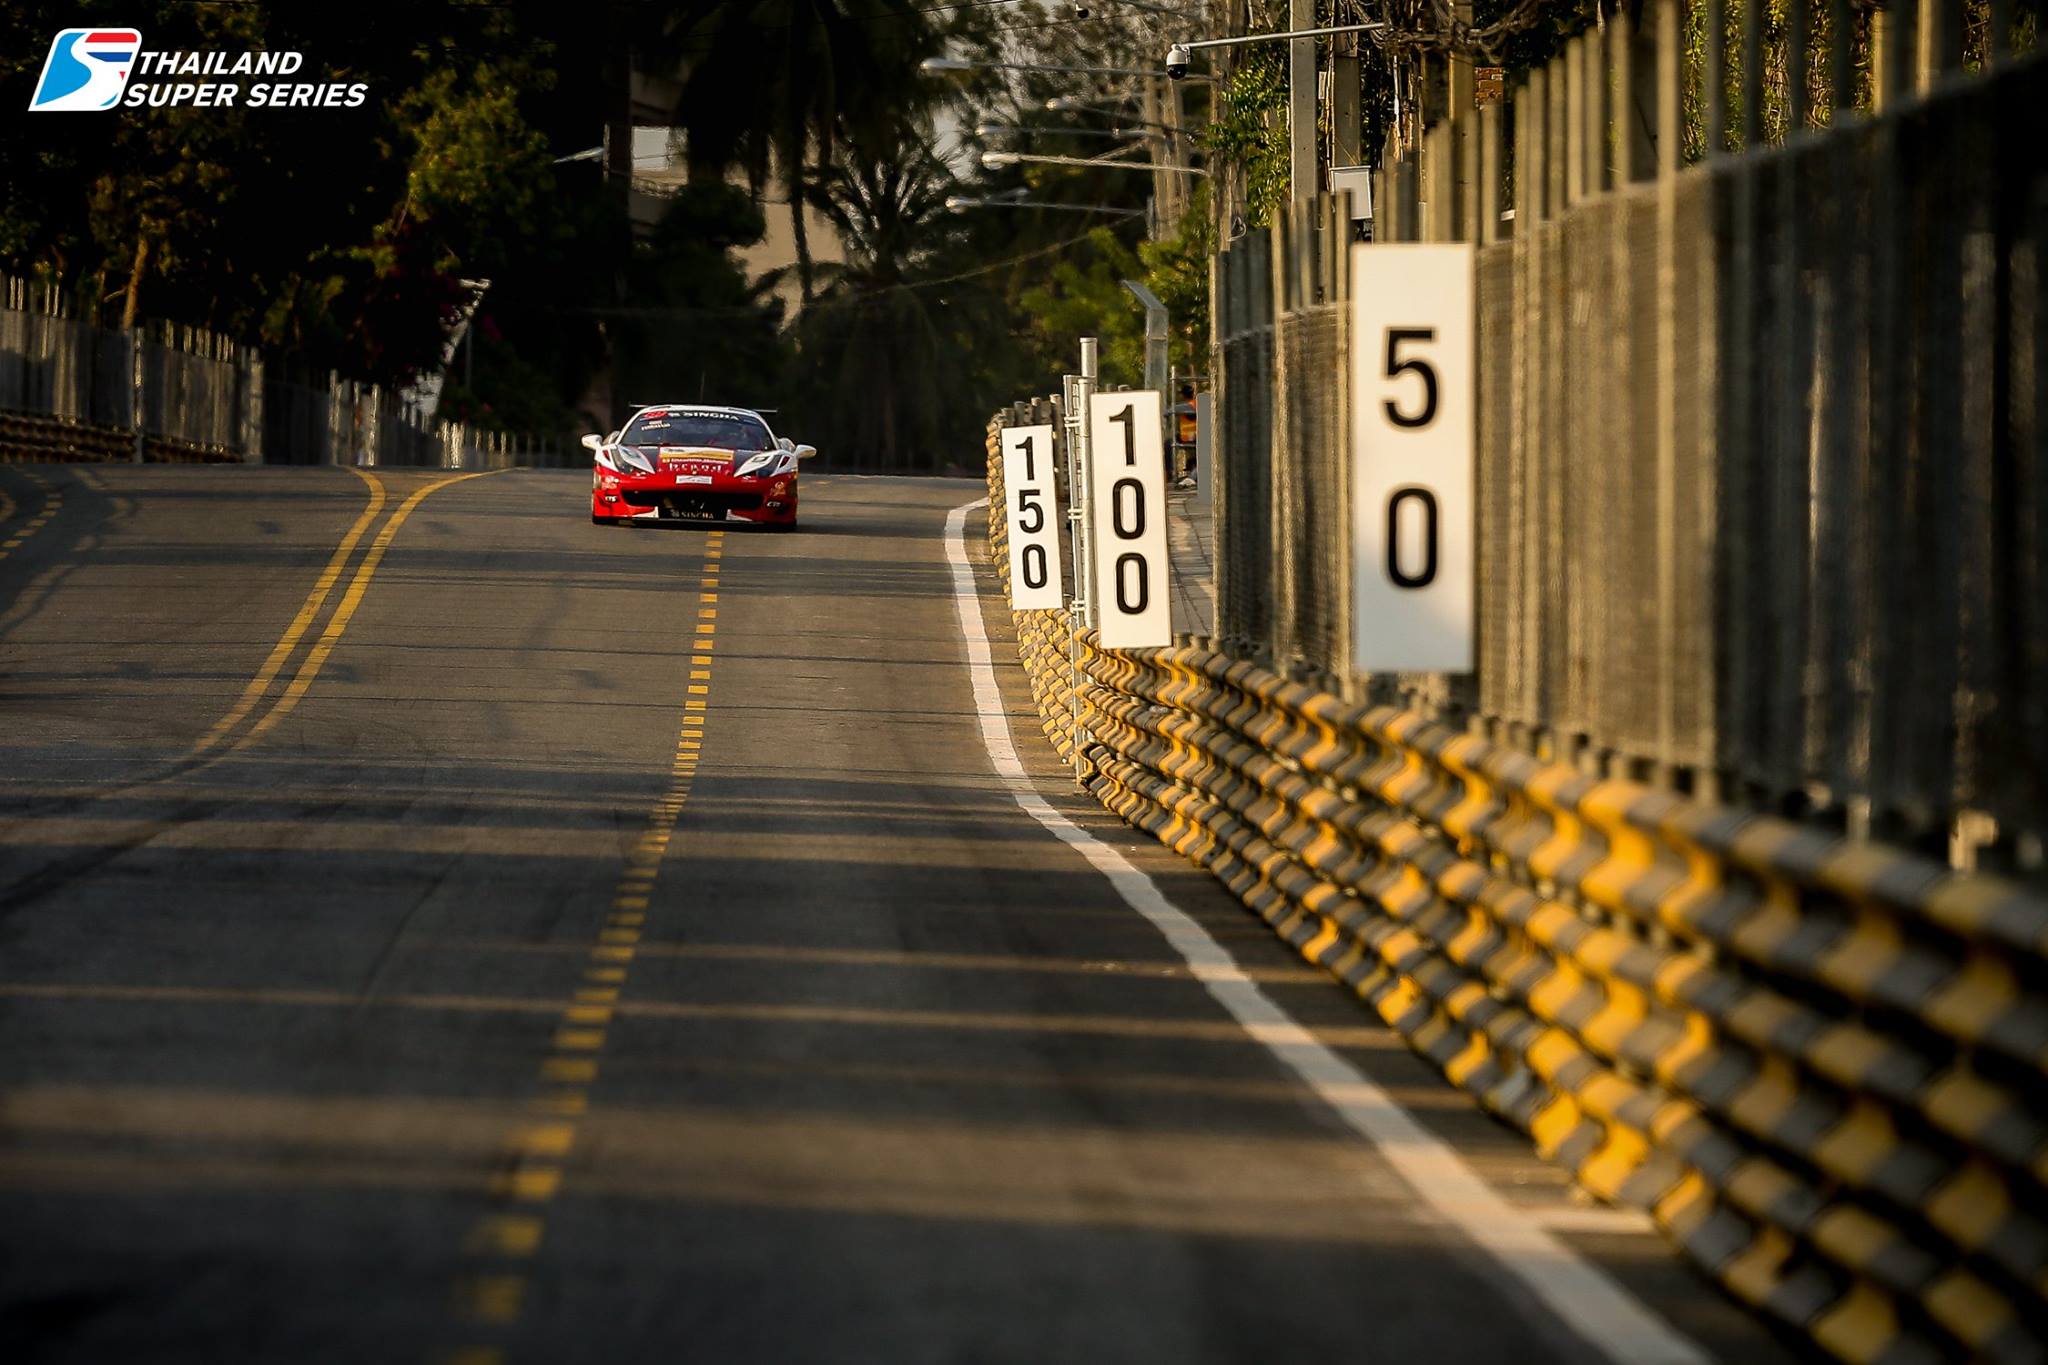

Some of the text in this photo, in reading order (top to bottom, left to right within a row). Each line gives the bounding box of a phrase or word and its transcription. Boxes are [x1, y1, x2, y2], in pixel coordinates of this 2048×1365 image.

[1014, 435, 1048, 589] 150
[1108, 404, 1149, 615] 100
[1384, 328, 1439, 589] 50
